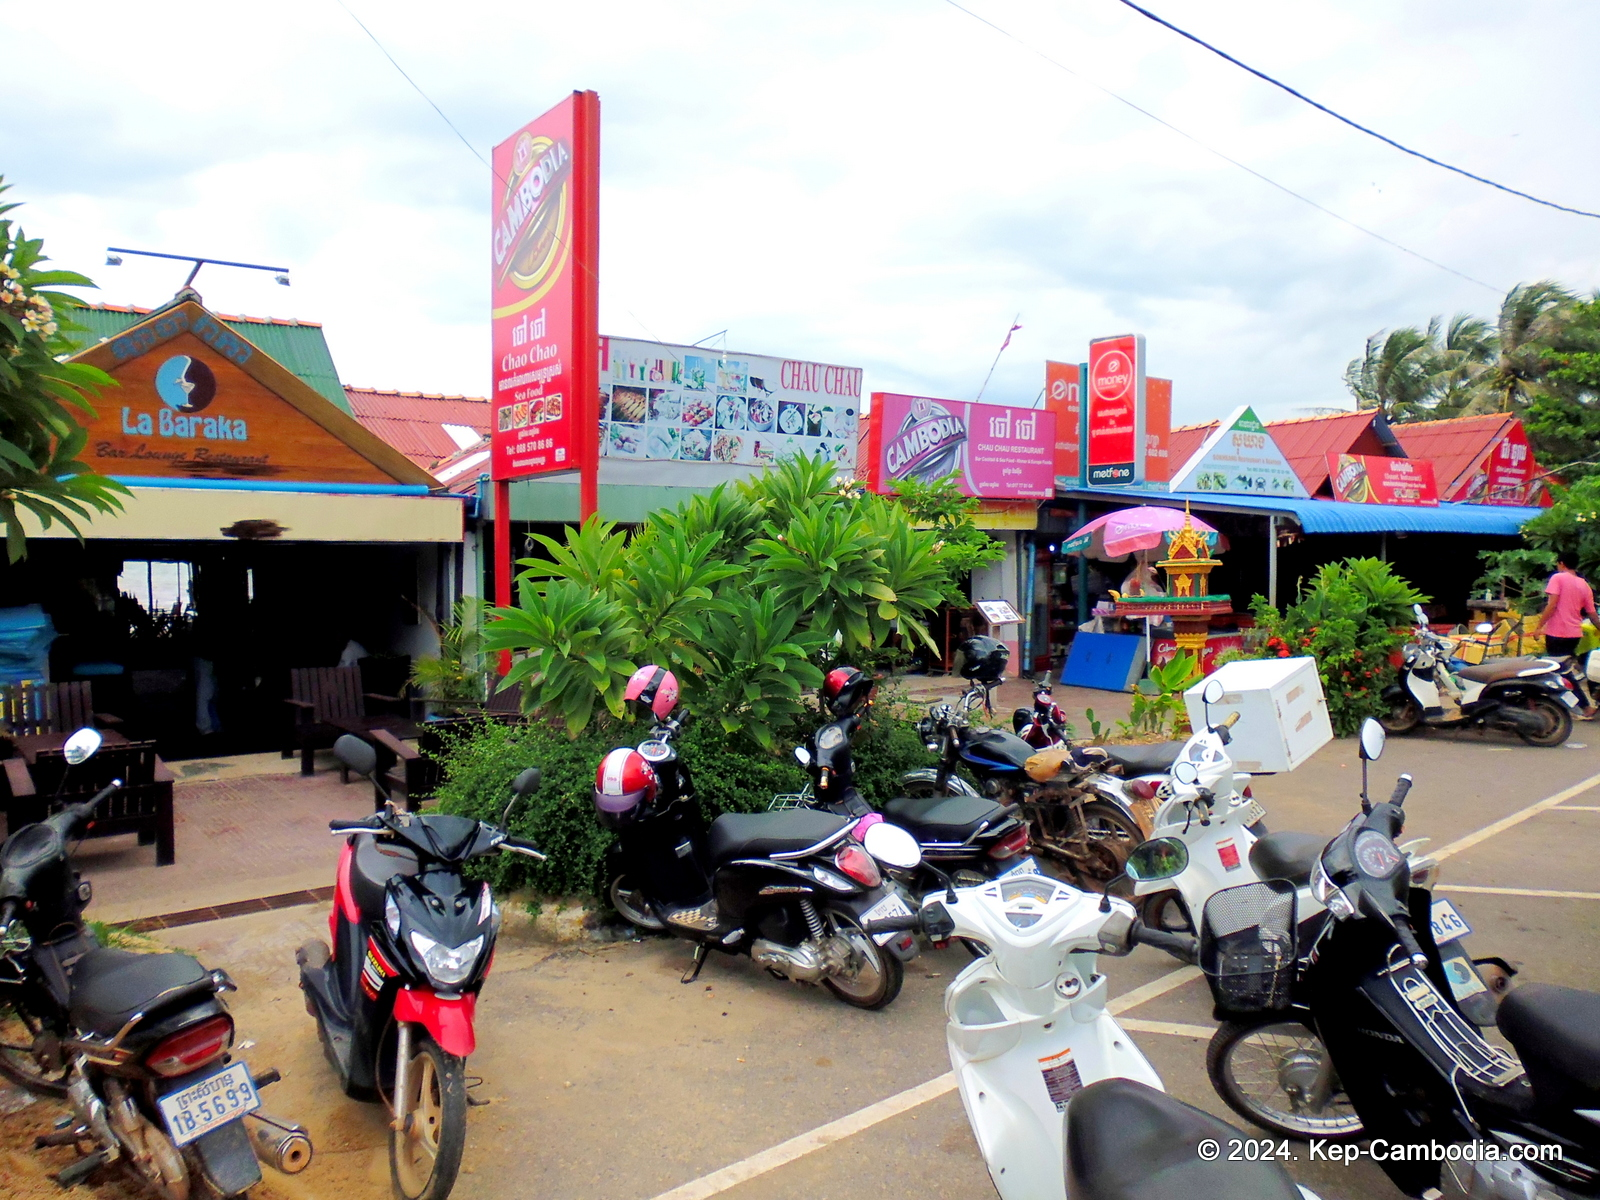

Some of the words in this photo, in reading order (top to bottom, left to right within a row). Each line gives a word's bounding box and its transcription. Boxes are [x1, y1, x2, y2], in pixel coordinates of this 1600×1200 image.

[494, 141, 569, 265] CAMBODIA
[501, 352, 528, 373] Chao
[529, 343, 558, 364] Chao
[780, 359, 823, 393] CHAU
[824, 365, 862, 398] CHAU
[1098, 373, 1129, 387] money
[514, 391, 526, 402] Sea
[121, 406, 153, 436] La
[158, 407, 248, 441] Baraka
[95, 440, 126, 459] Bar
[127, 443, 187, 465] Lounge
[193, 447, 270, 465] Restaurant
[886, 416, 964, 474] CAMBODIA
[977, 443, 993, 452] CHAU
[994, 444, 1010, 453] CHAU
[1010, 446, 1045, 455] RESTAURANT
[1093, 467, 1130, 478] metfone
[1335, 462, 1365, 494] CAMBODIA
[367, 950, 386, 978] SUZUKI
[1357, 1027, 1405, 1045] HONDA
[172, 1082, 252, 1135] 1B-5699
